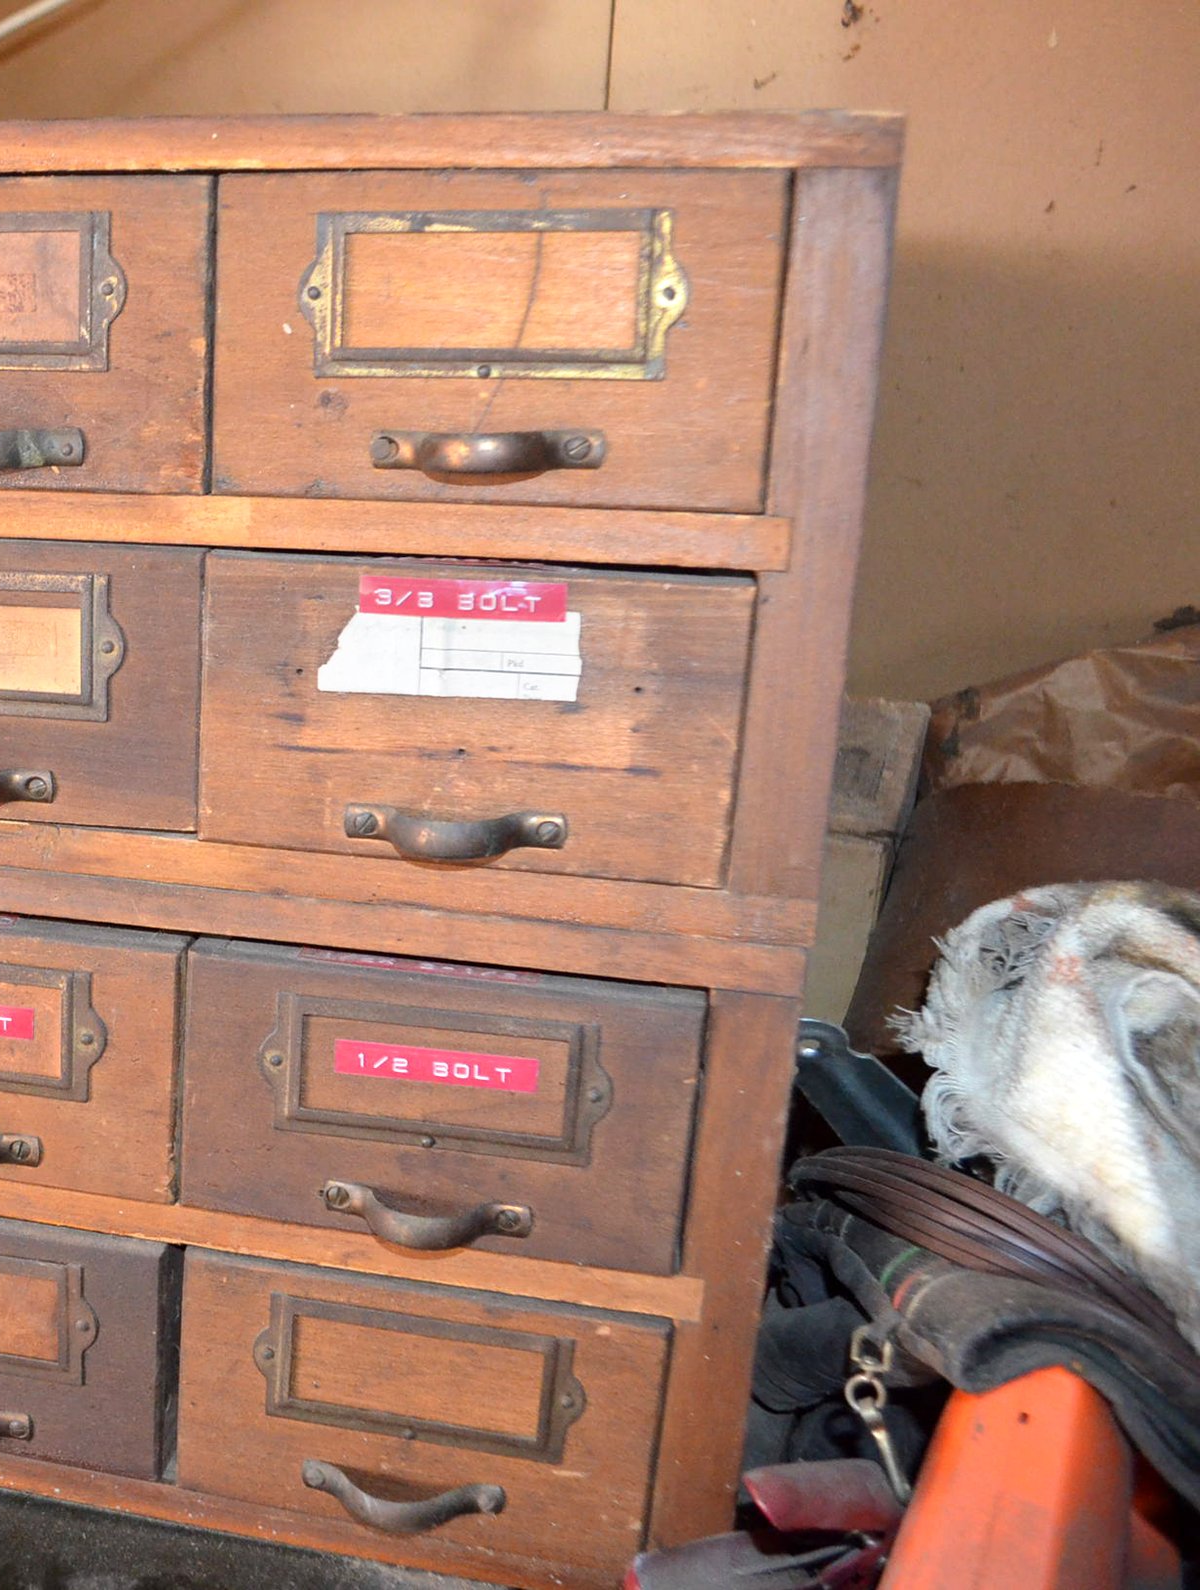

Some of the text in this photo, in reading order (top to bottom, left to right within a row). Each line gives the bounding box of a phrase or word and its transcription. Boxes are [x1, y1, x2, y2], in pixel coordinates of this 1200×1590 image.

[457, 592, 543, 613] BOLT
[357, 1053, 513, 1083] 1/2 BOLT
